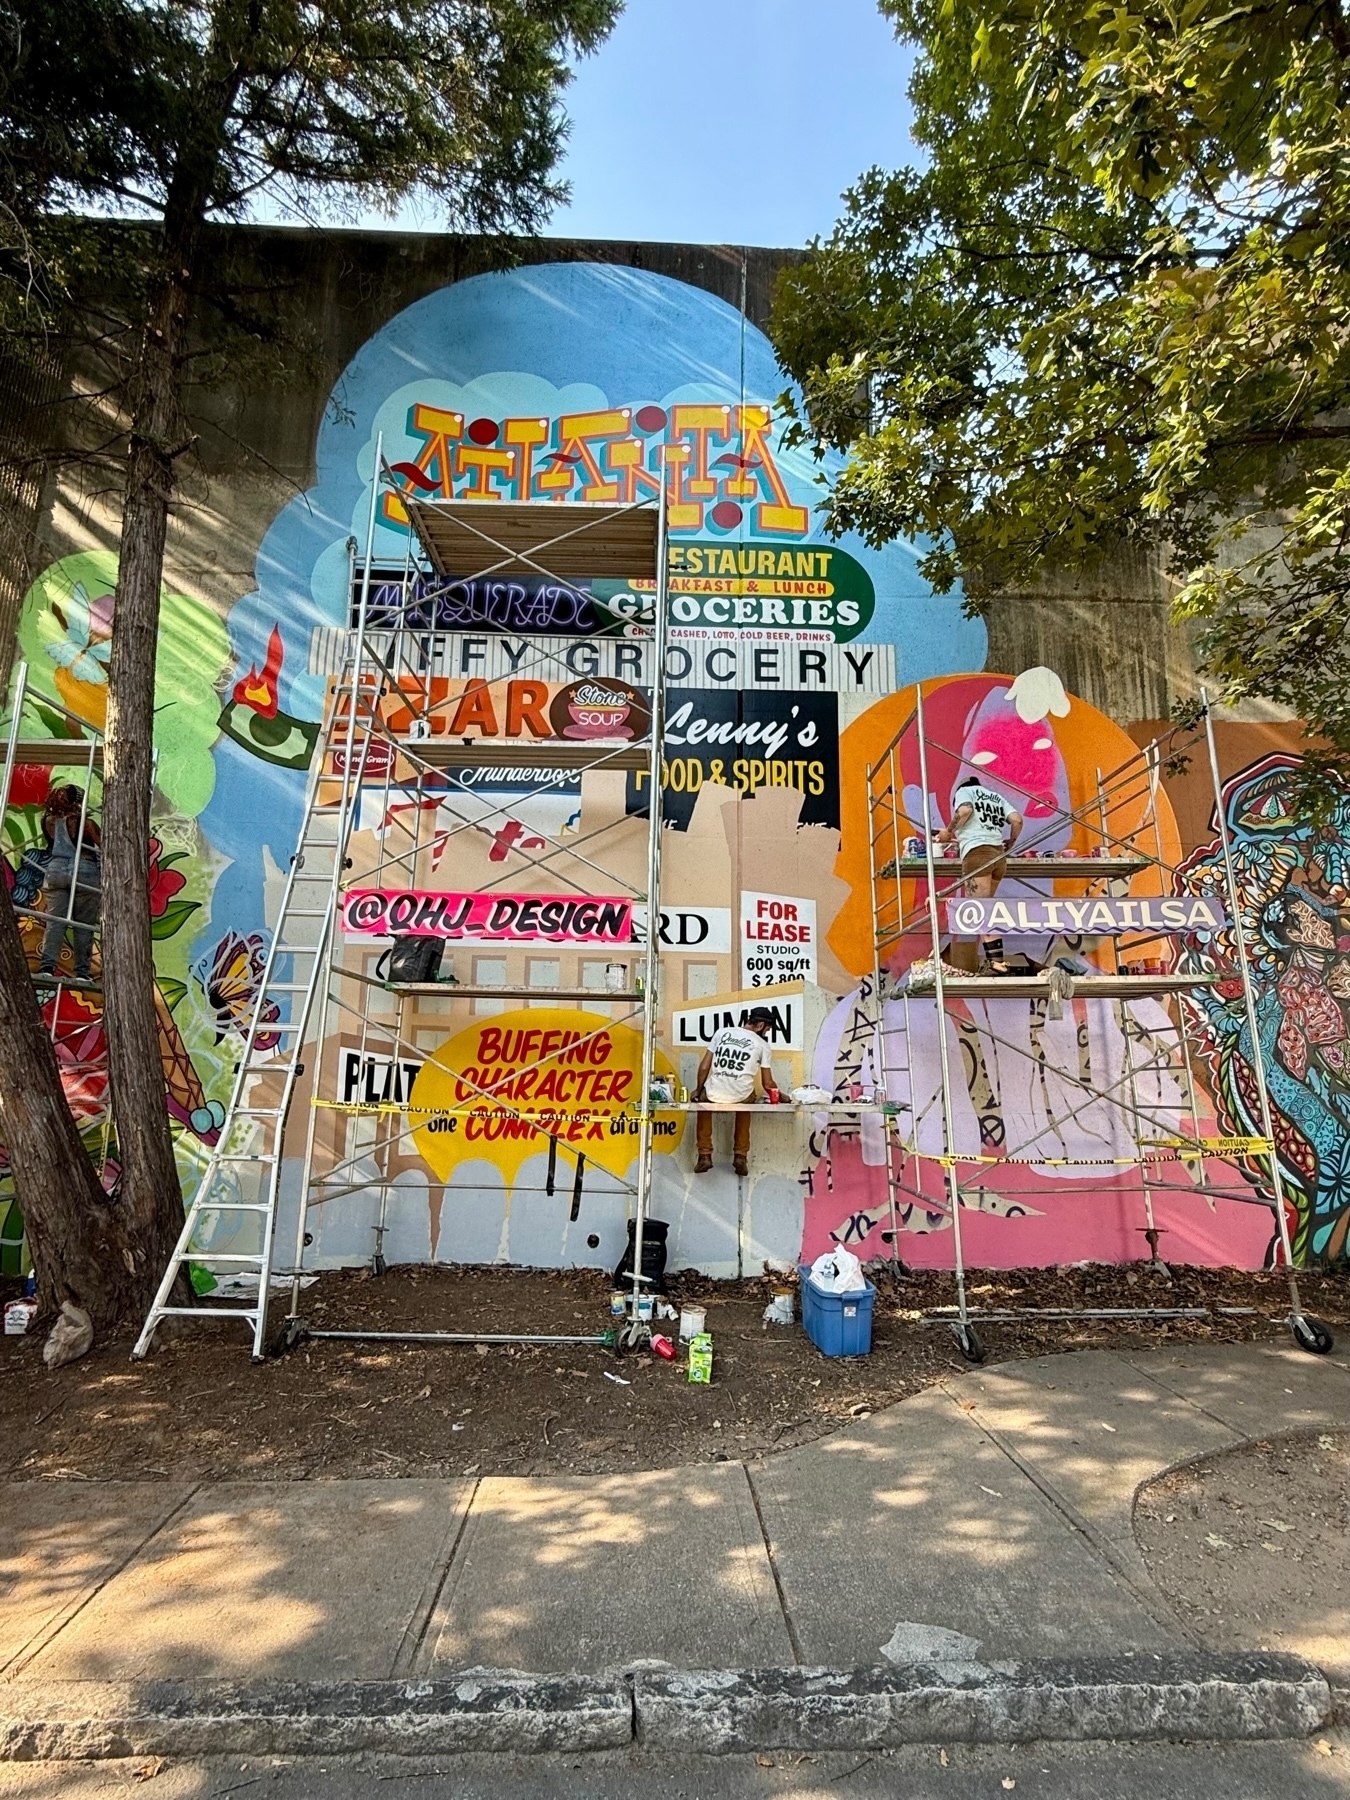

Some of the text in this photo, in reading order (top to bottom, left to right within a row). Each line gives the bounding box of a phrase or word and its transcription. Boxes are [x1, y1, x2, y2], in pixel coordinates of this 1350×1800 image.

[379, 403, 808, 538] ATLANTA
[668, 548, 832, 577] ESTAURANT
[636, 579, 827, 594] BRAKFAST & LUNCH
[671, 629, 710, 640] CASHED,
[740, 632, 763, 640] COLD
[766, 633, 793, 642] BEER,
[796, 633, 831, 642] DRINKS
[566, 642, 874, 684] GROCERY
[574, 684, 628, 707] Stone
[579, 712, 624, 726] SOUP
[664, 701, 820, 759] Lenny's
[709, 759, 727, 785] &
[733, 760, 824, 795] SPIRITS
[347, 893, 627, 937] @QHJ_DESIGN
[757, 900, 797, 921] FOR
[955, 900, 1218, 932] @ALIYAILSA
[746, 921, 810, 942] LEASE
[757, 945, 800, 955] STUDIO
[747, 958, 810, 972] 600 sq/ft
[752, 974, 761, 987] $
[680, 1004, 791, 1043] LUN
[477, 1028, 612, 1064] BUFFING
[715, 1047, 751, 1061] HAND
[714, 1058, 745, 1071] JOBS
[455, 1067, 632, 1102] CHARACTER
[400, 1106, 449, 1115] CAUTION
[470, 1111, 520, 1119] CAUTION
[540, 1113, 590, 1122] CAUTION
[427, 1117, 457, 1133] one
[465, 1106, 611, 1141] COMPLEX
[653, 1121, 676, 1135] me
[1201, 1147, 1248, 1158] CAUTION
